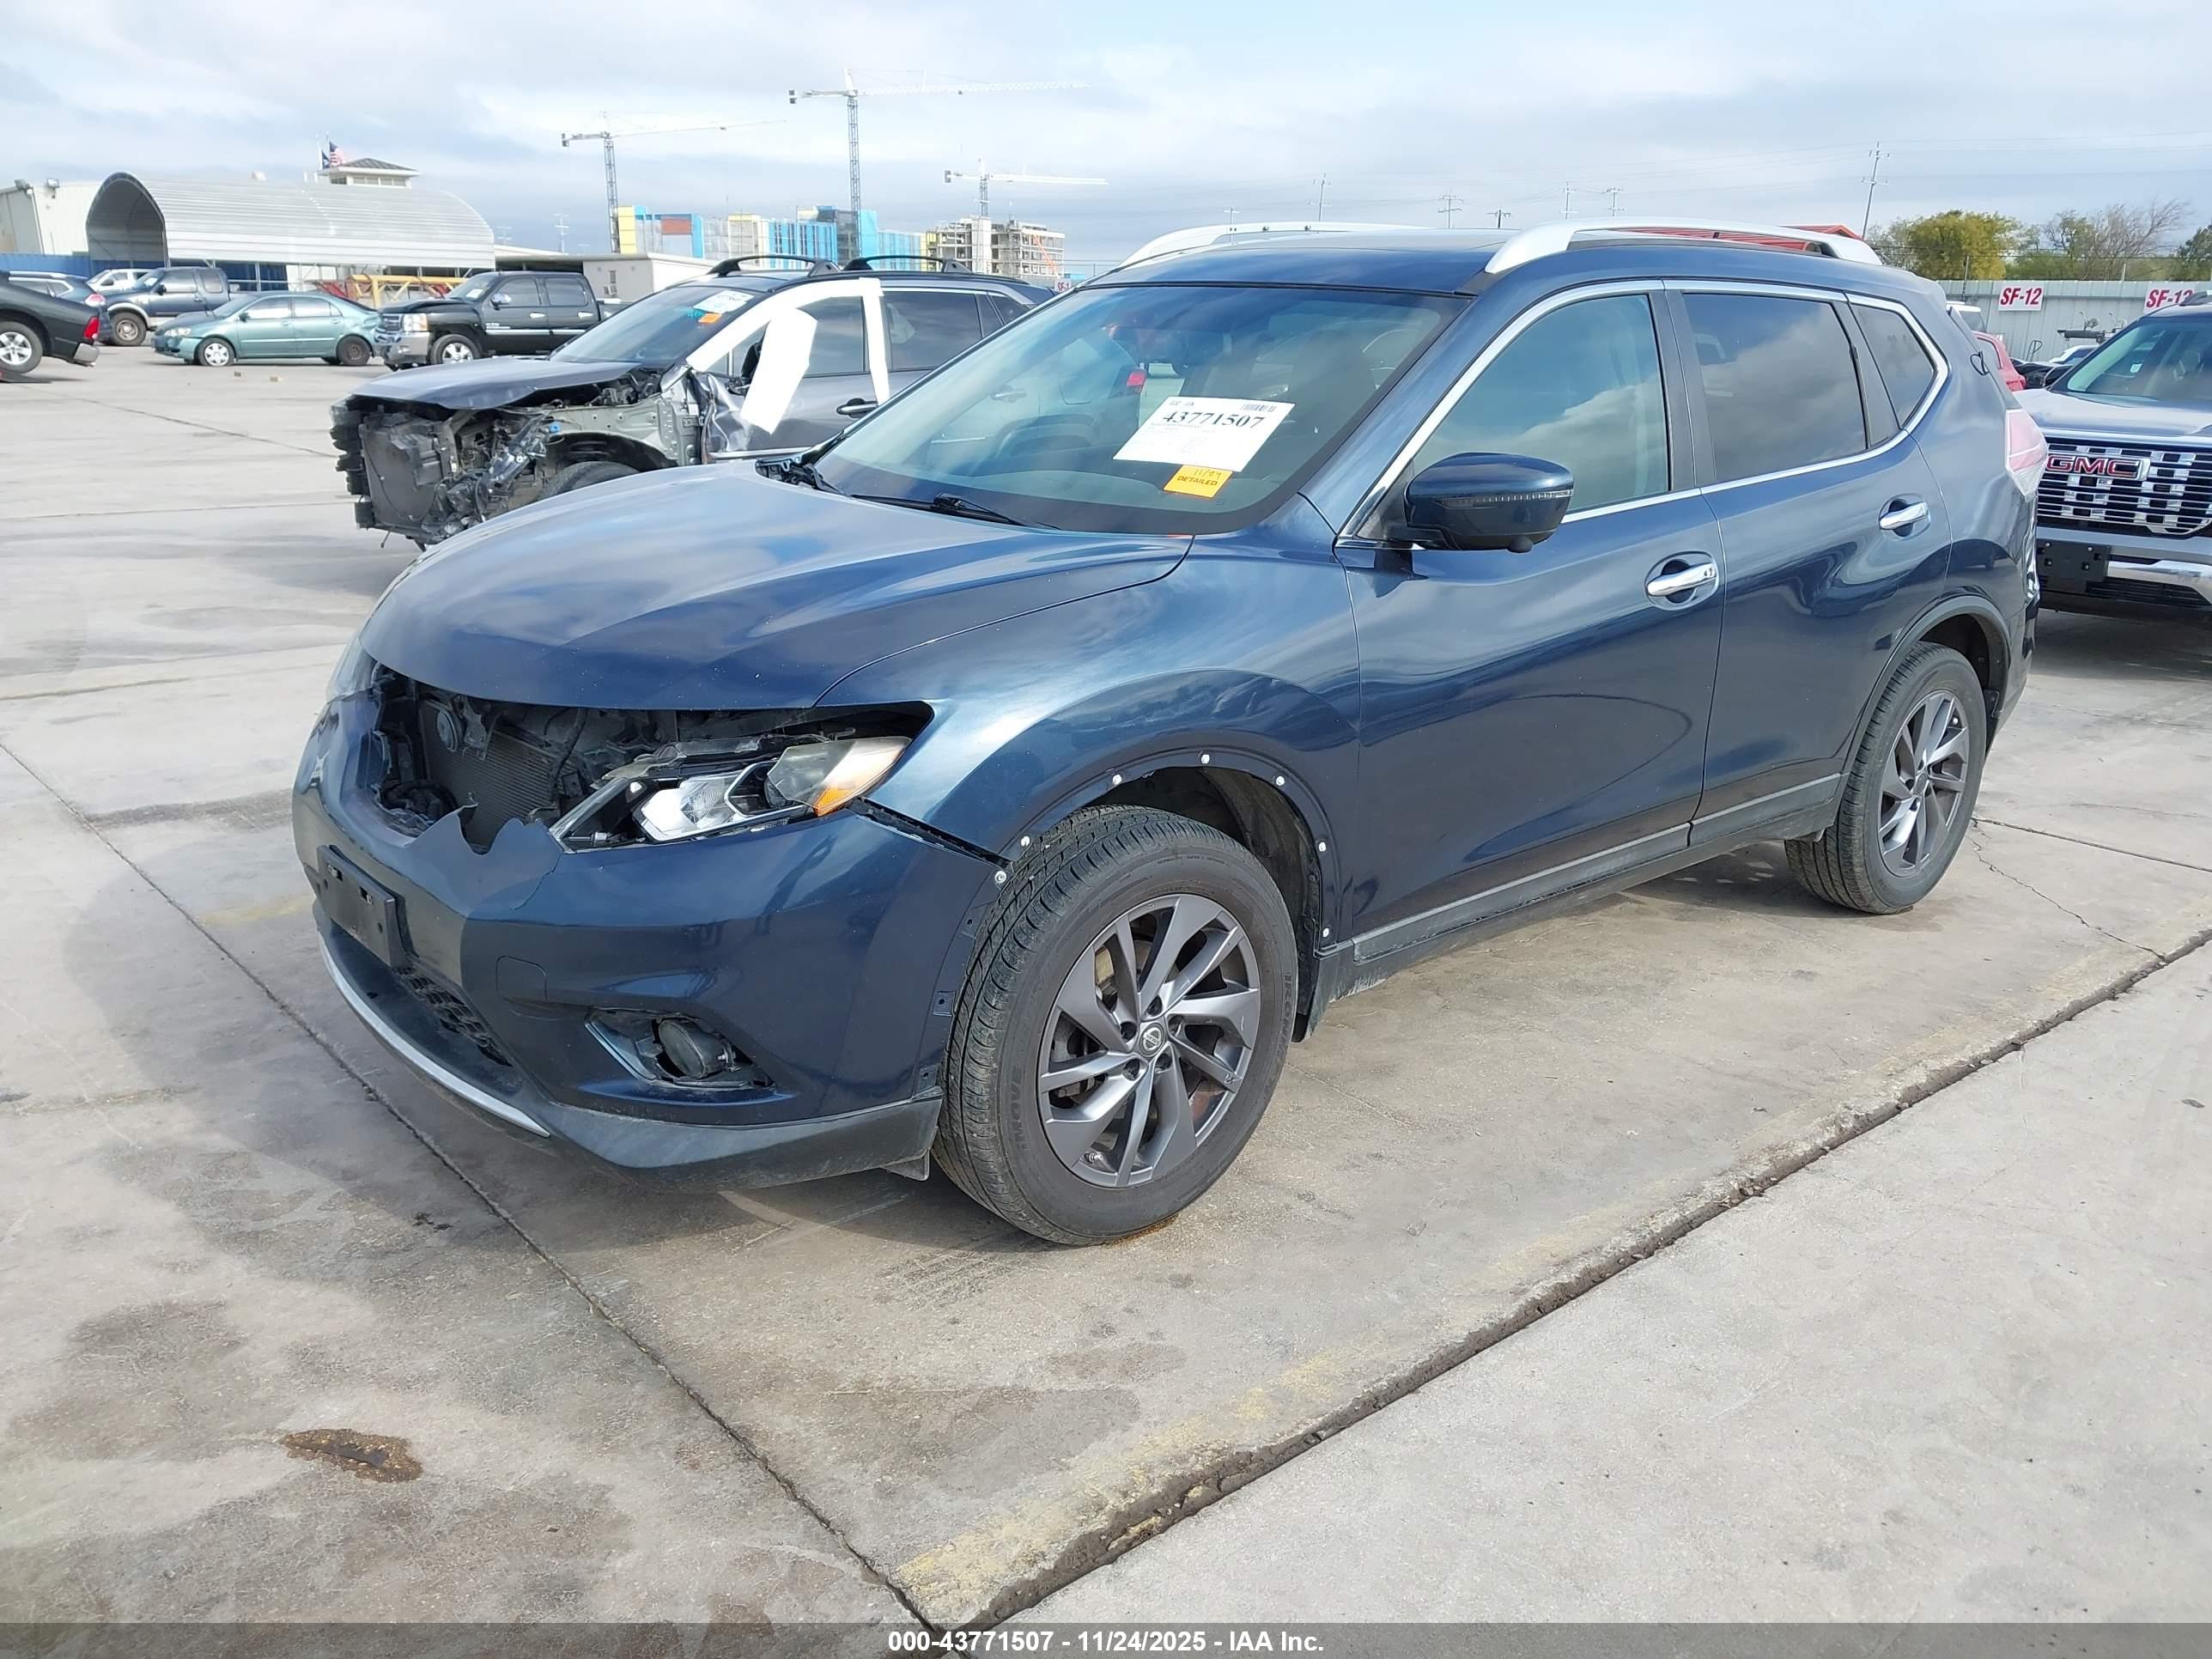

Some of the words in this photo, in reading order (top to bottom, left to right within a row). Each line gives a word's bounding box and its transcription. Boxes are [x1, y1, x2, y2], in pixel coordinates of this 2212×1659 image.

[2000, 288, 2043, 306] SF-12
[1163, 410, 1266, 428] 43771507
[2045, 454, 2141, 478] GMC
[1177, 476, 1218, 486] DETAILED
